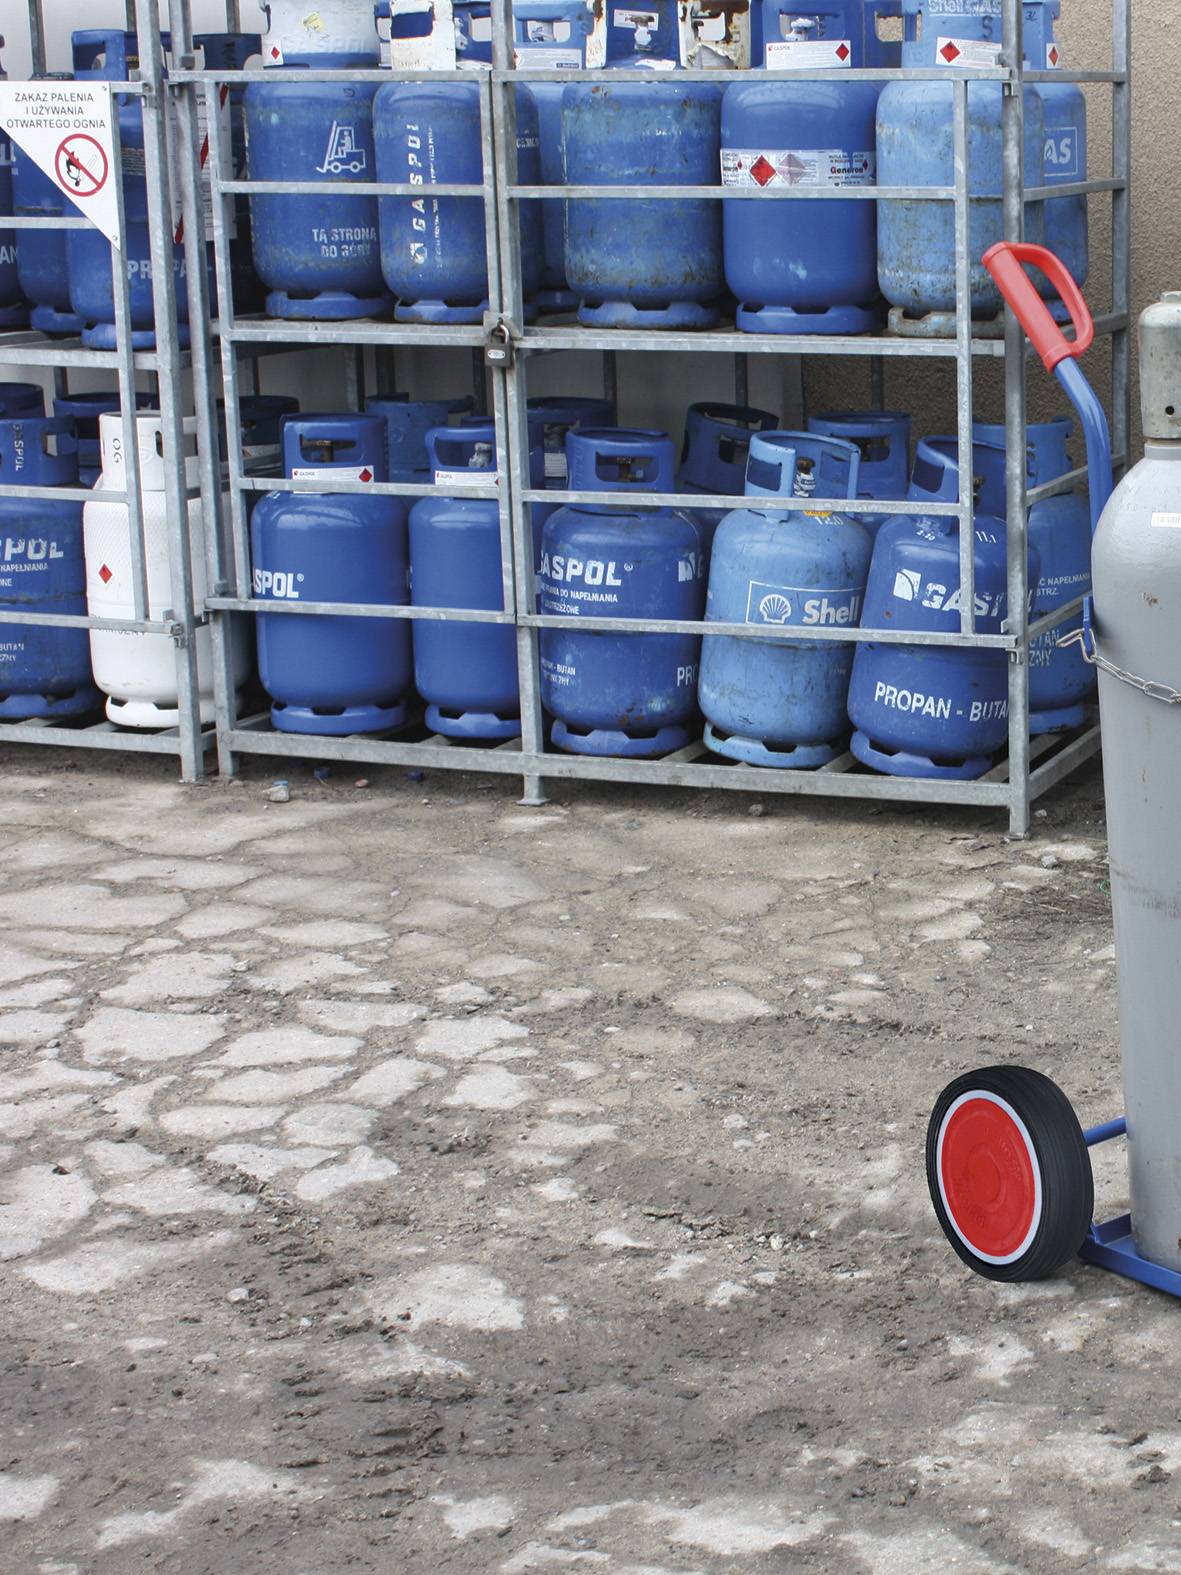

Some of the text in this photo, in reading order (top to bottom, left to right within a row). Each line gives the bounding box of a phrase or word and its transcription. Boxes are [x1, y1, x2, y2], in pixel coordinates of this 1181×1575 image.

[15, 93, 94, 102] ZAKAZ PALENIA
[26, 105, 84, 115] I UŻYWANIA
[6, 119, 106, 128] OTWARTEGO OGNIA
[0, 537, 64, 560] POL
[541, 551, 622, 587] ASPOL
[253, 569, 299, 599] SPOL
[570, 590, 618, 603] NAPEŁNIANIA
[802, 597, 860, 625] Shell
[875, 682, 951, 719] PROPAN
